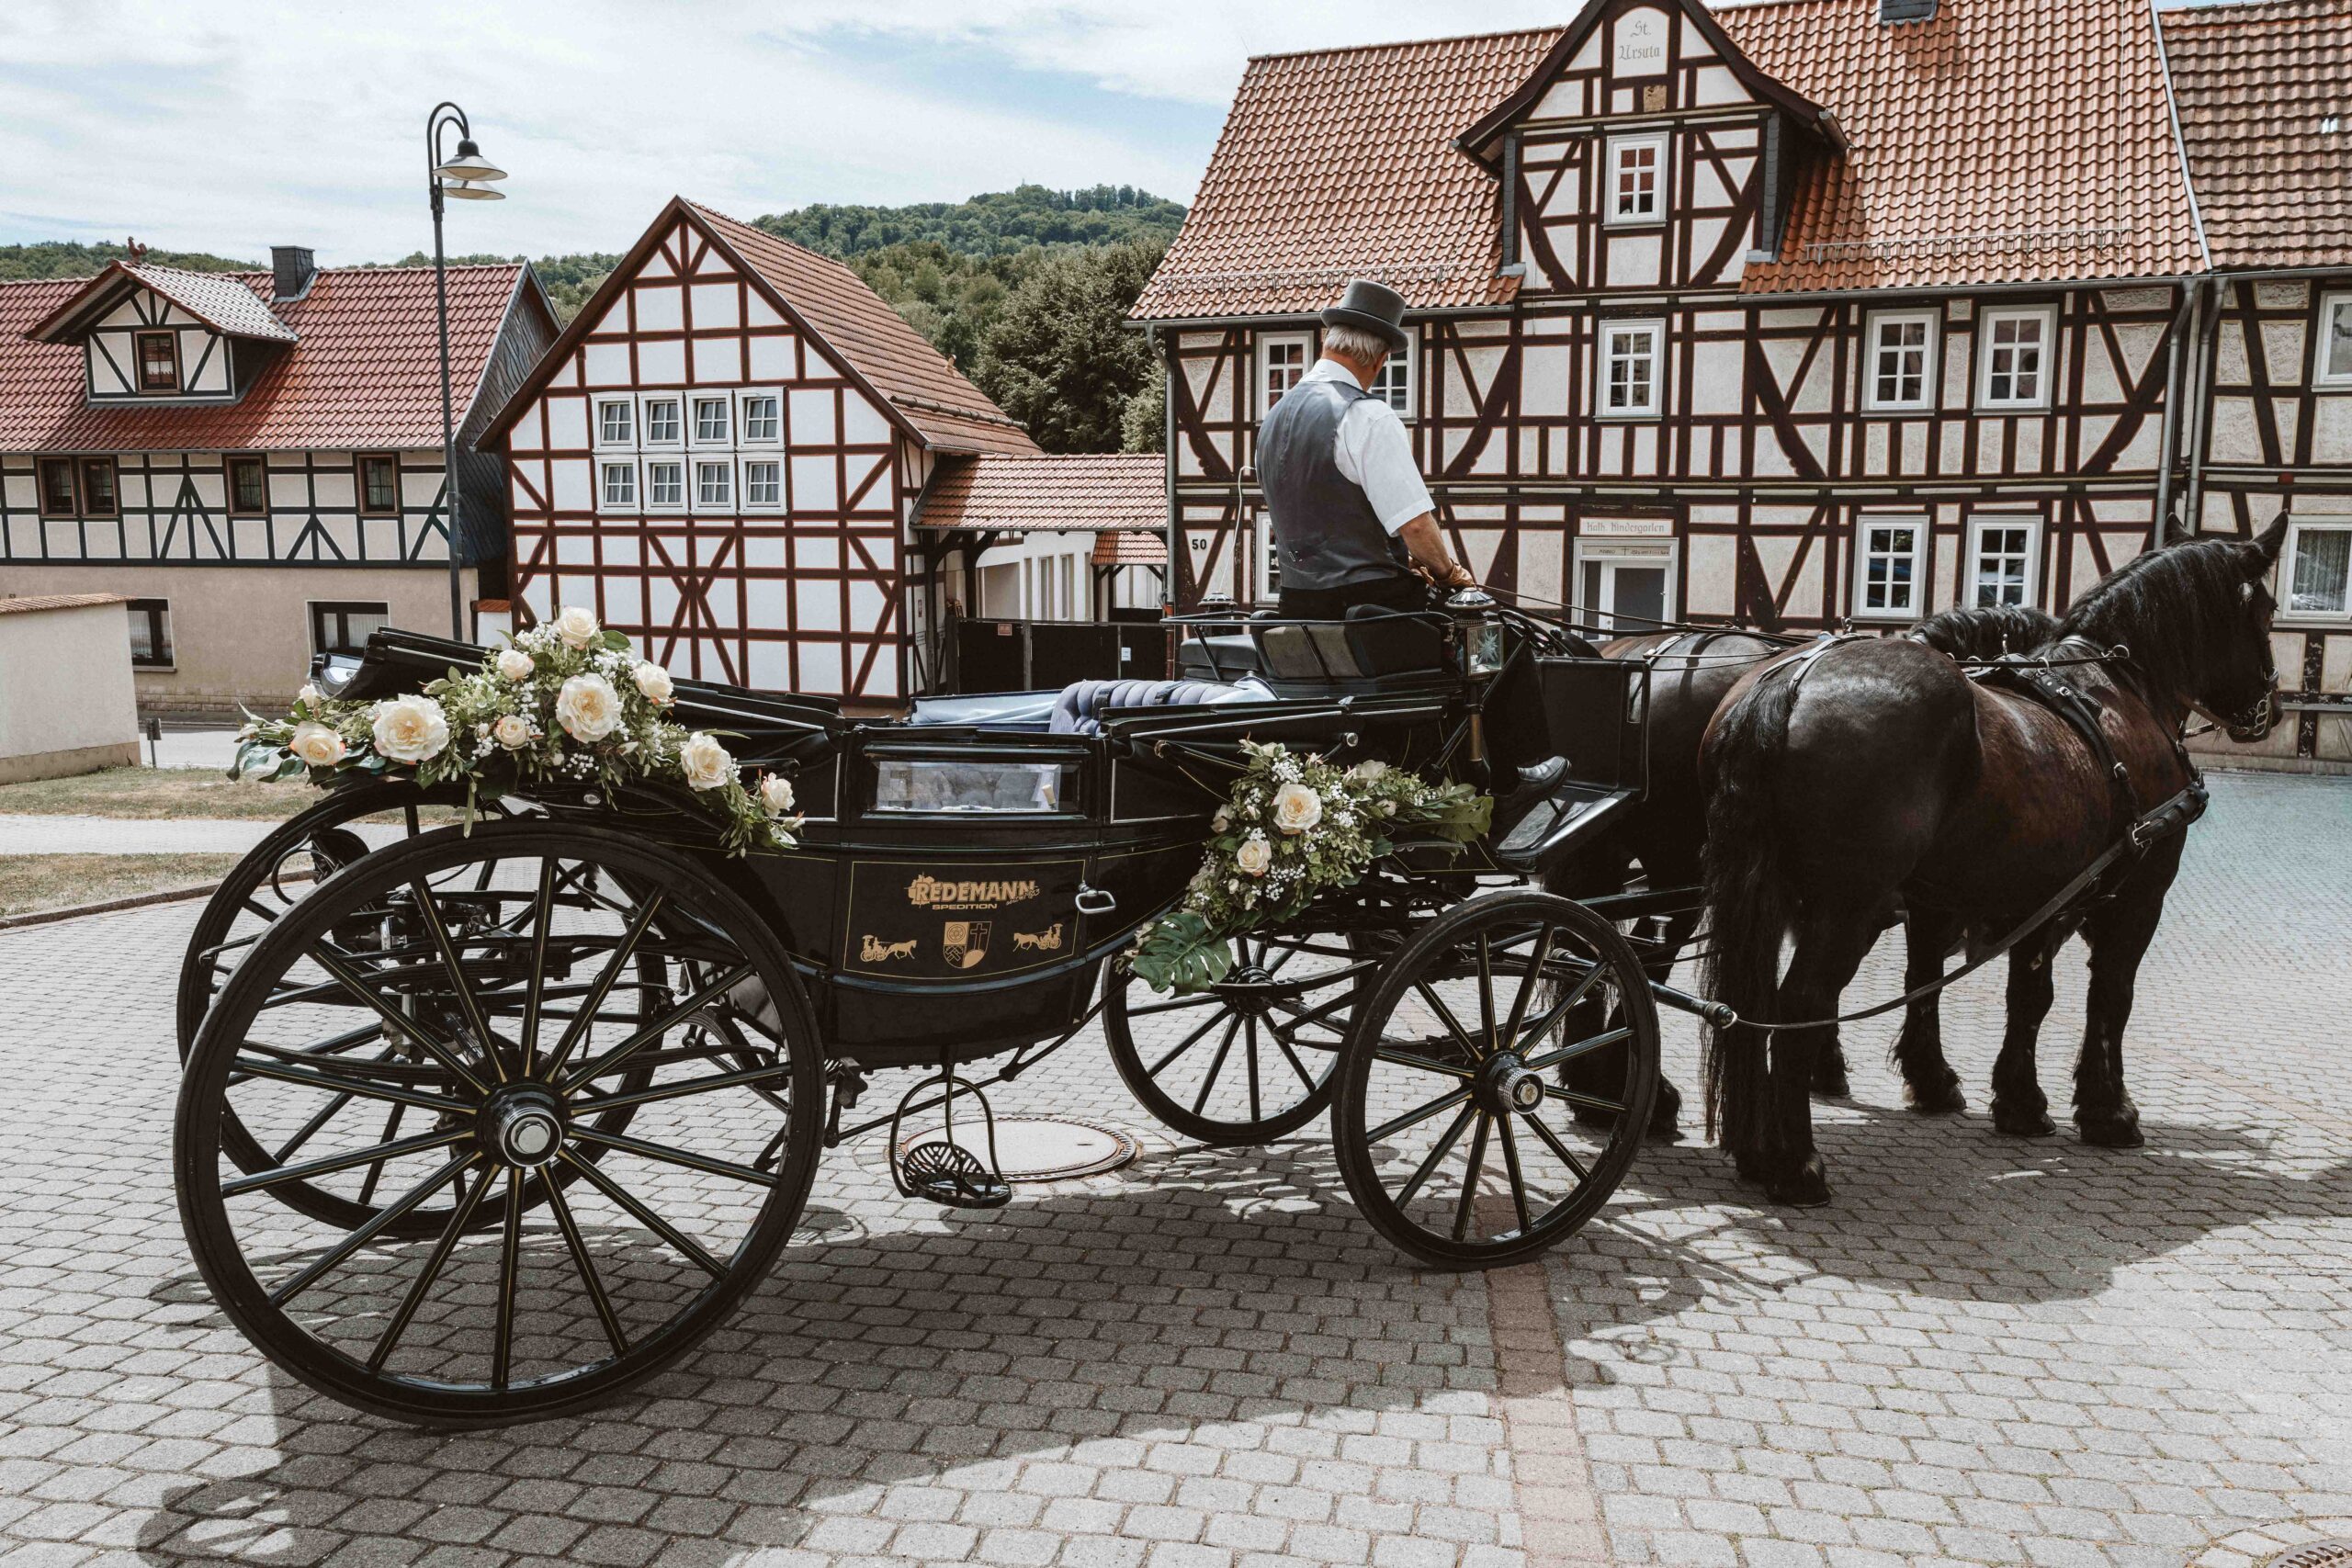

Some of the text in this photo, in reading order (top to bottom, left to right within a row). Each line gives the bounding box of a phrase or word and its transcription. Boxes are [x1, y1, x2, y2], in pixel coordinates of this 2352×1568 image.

[1630, 20, 1652, 37] St.
[1618, 44, 1661, 61] Ursula
[1611, 522, 1665, 534] Kindergarten
[1192, 538, 1207, 550] 50
[915, 880, 1036, 903] REDEMANN
